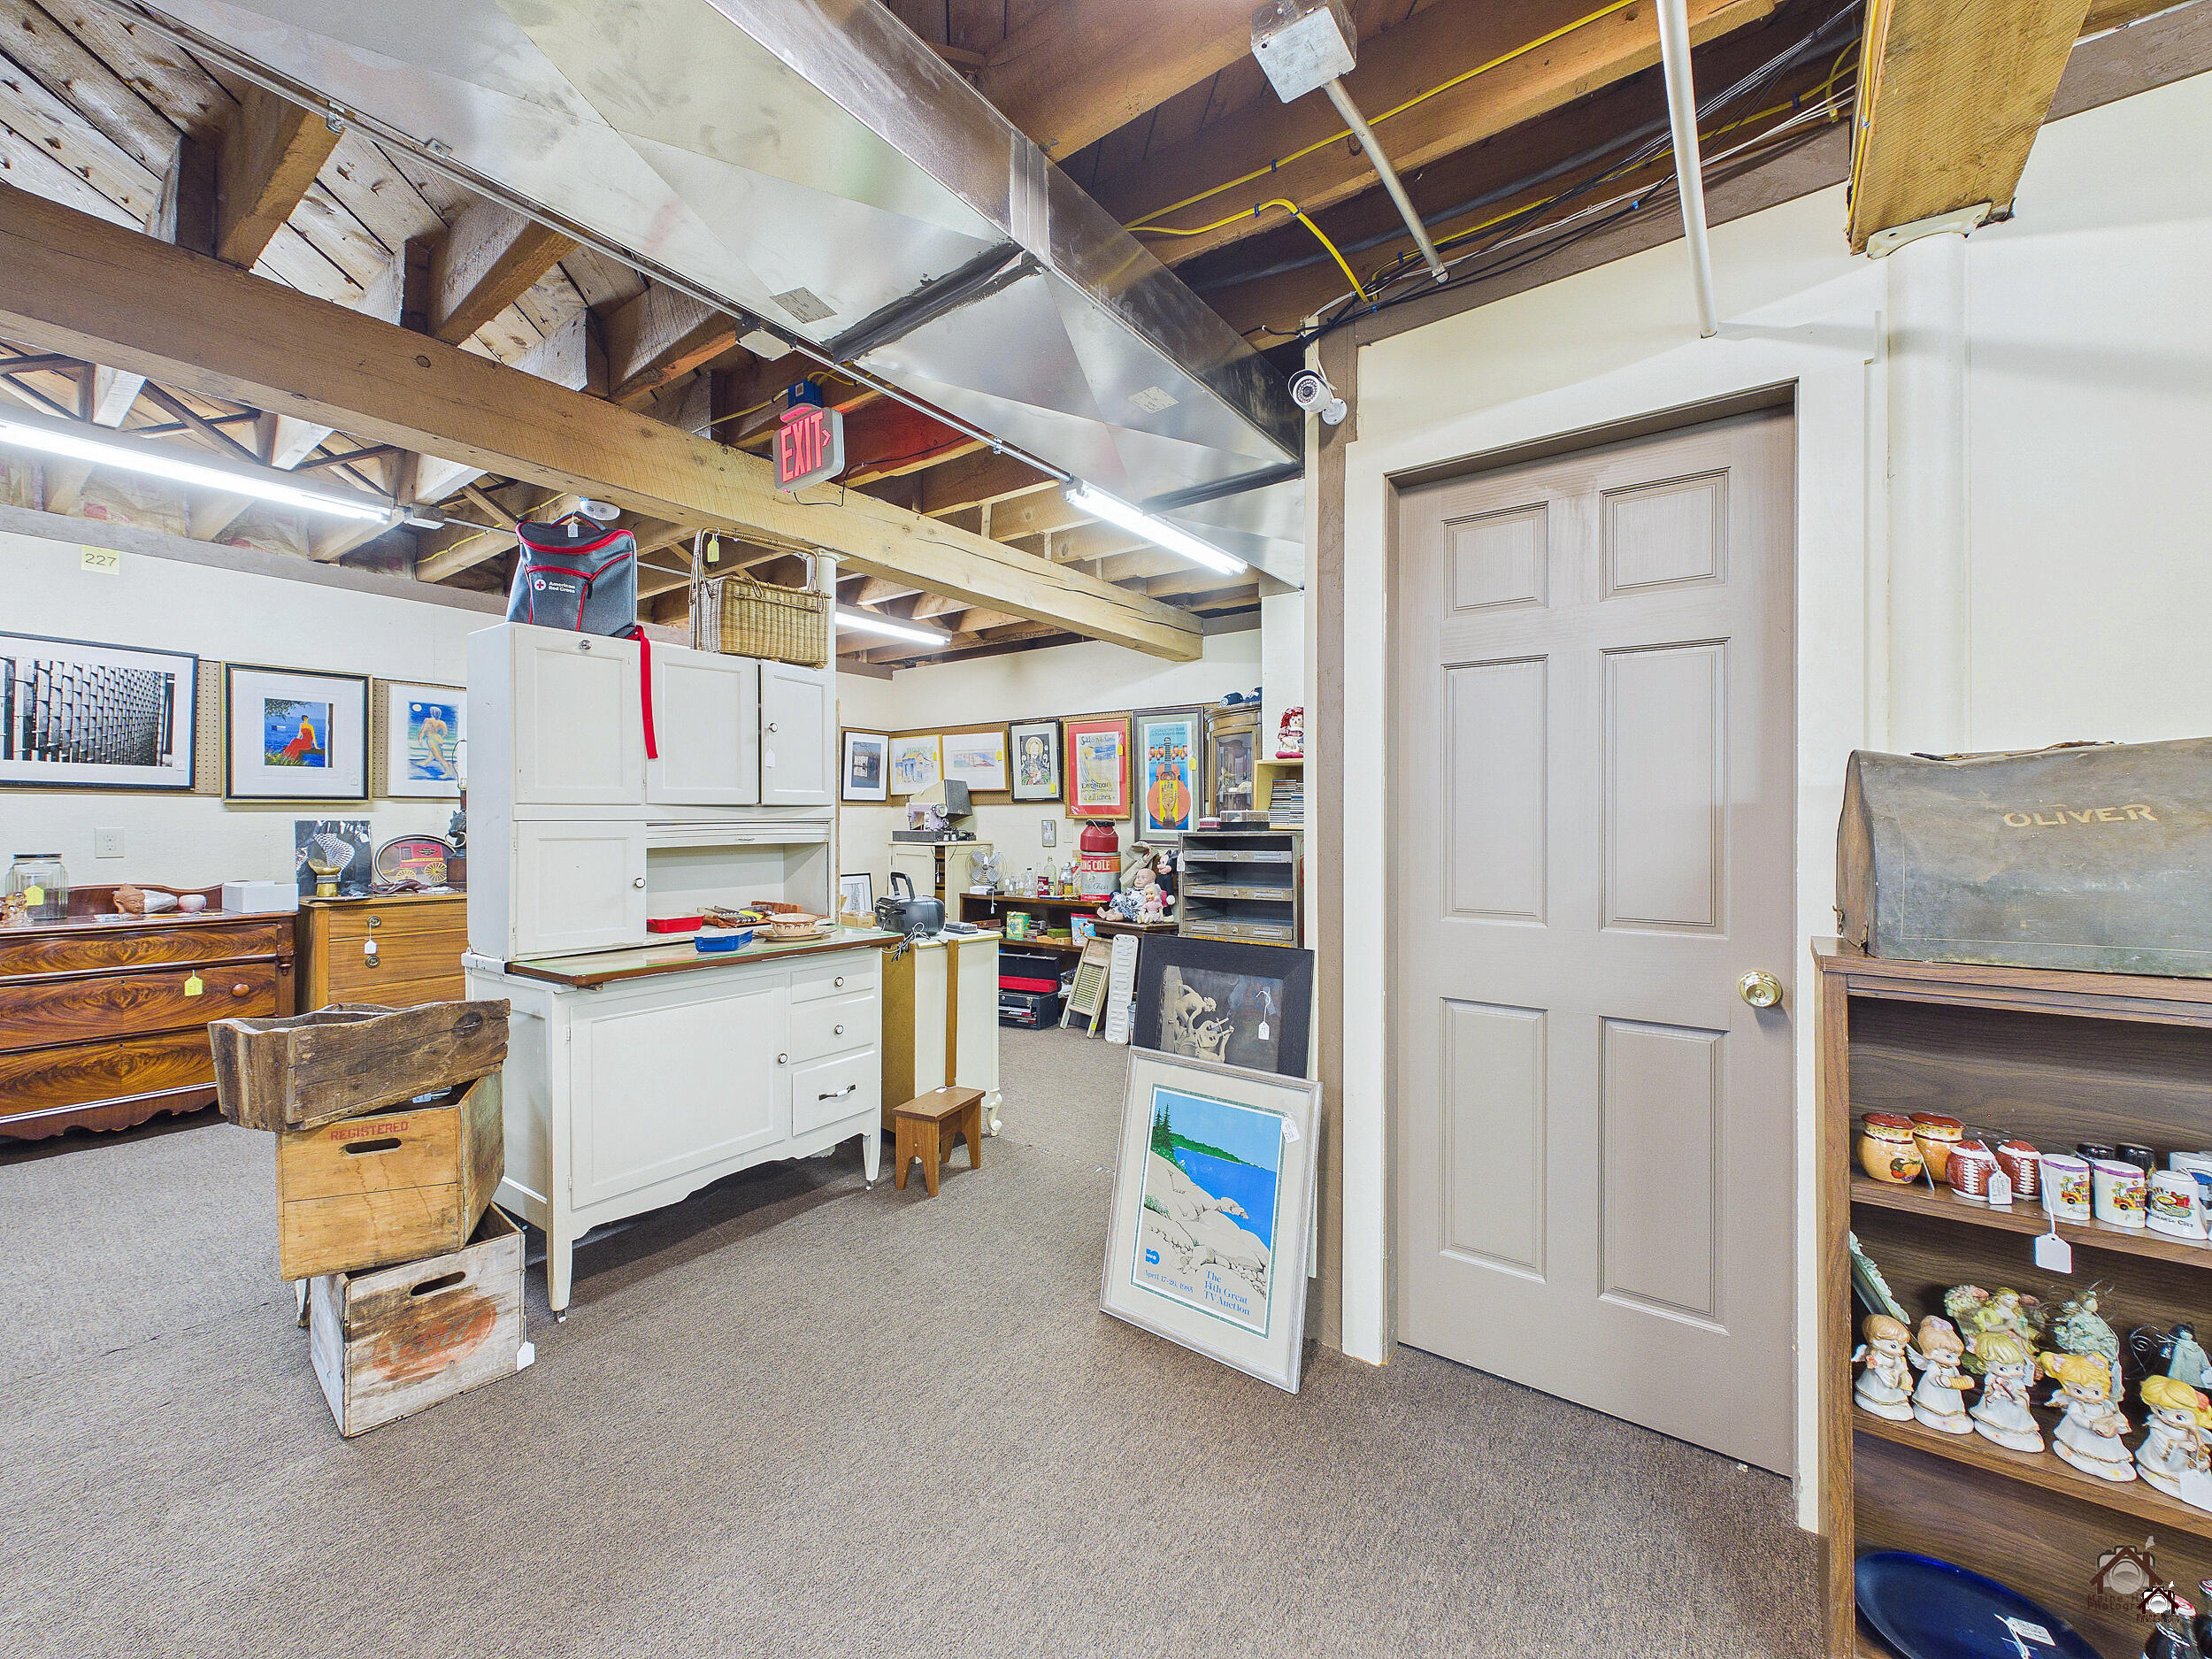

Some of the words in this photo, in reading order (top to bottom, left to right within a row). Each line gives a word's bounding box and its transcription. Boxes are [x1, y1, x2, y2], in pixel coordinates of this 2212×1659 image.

[780, 410, 824, 482] EXIT
[84, 553, 119, 566] 227
[2003, 803, 2159, 827] OLIVER
[1093, 860, 1110, 871] COLE
[1111, 944, 1133, 1003] NOTCH
[330, 1121, 409, 1141] REGISTERED
[1145, 1269, 1159, 1280] April
[1206, 1270, 1221, 1282] The
[1204, 1280, 1221, 1294] 14th
[1224, 1287, 1248, 1304] Great
[1204, 1290, 1217, 1302] TV
[1217, 1296, 1250, 1316] Auction
